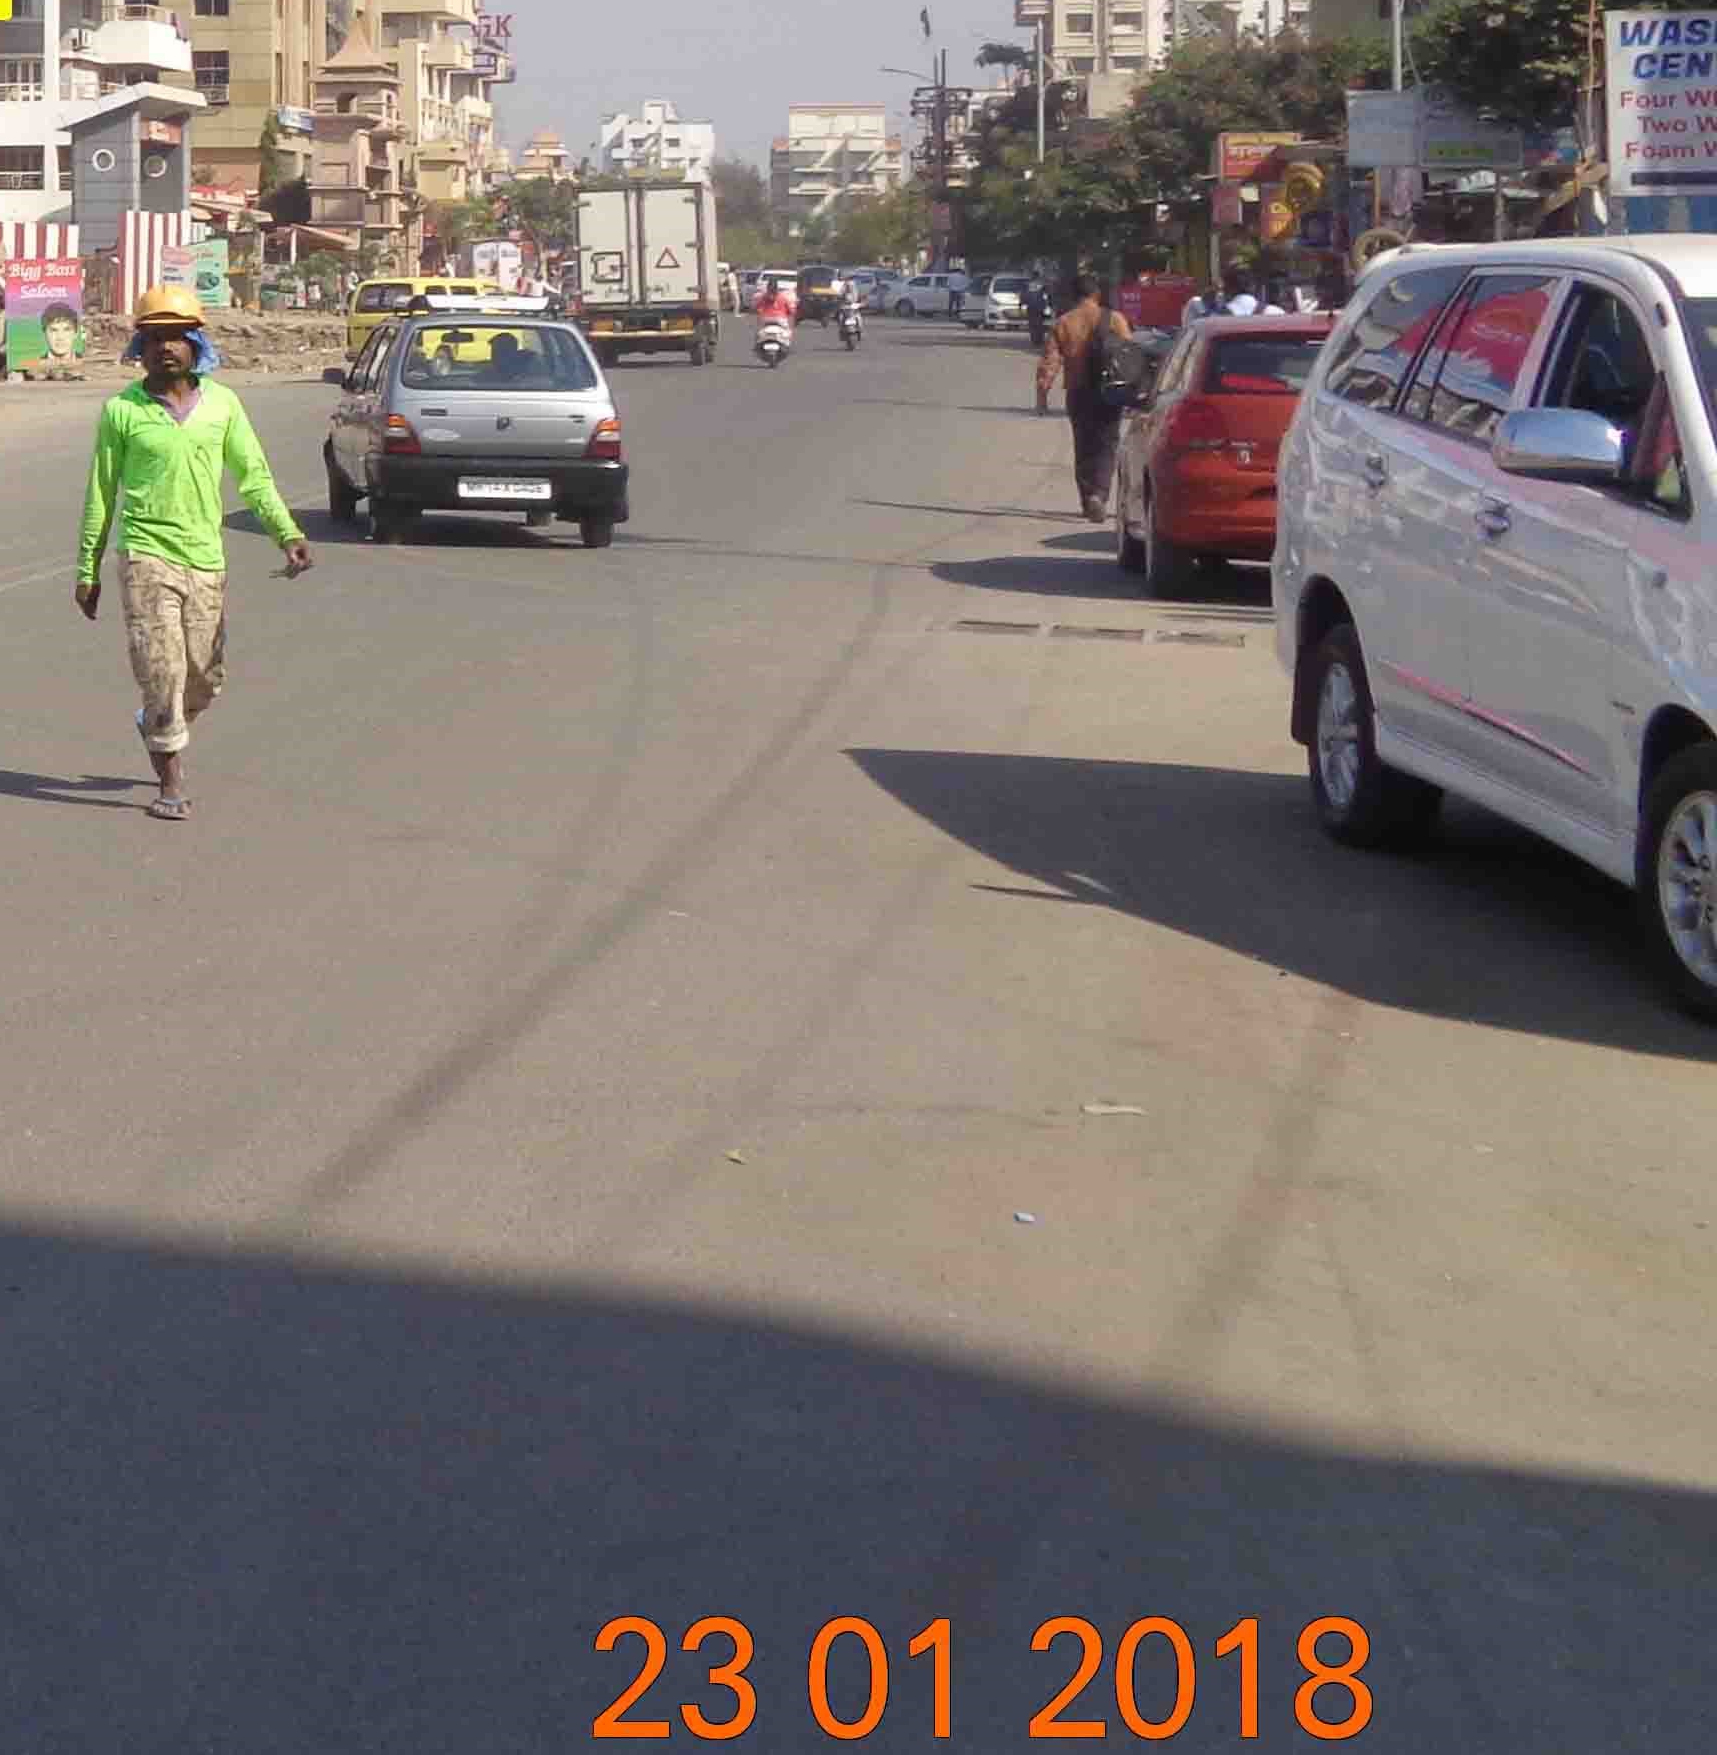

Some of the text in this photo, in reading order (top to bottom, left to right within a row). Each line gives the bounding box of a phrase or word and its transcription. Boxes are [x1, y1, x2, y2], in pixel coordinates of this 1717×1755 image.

[1620, 19, 1717, 46] WAS
[1621, 92, 1678, 109] Four
[1637, 116, 1688, 133] Two
[1626, 142, 1695, 158] Foam
